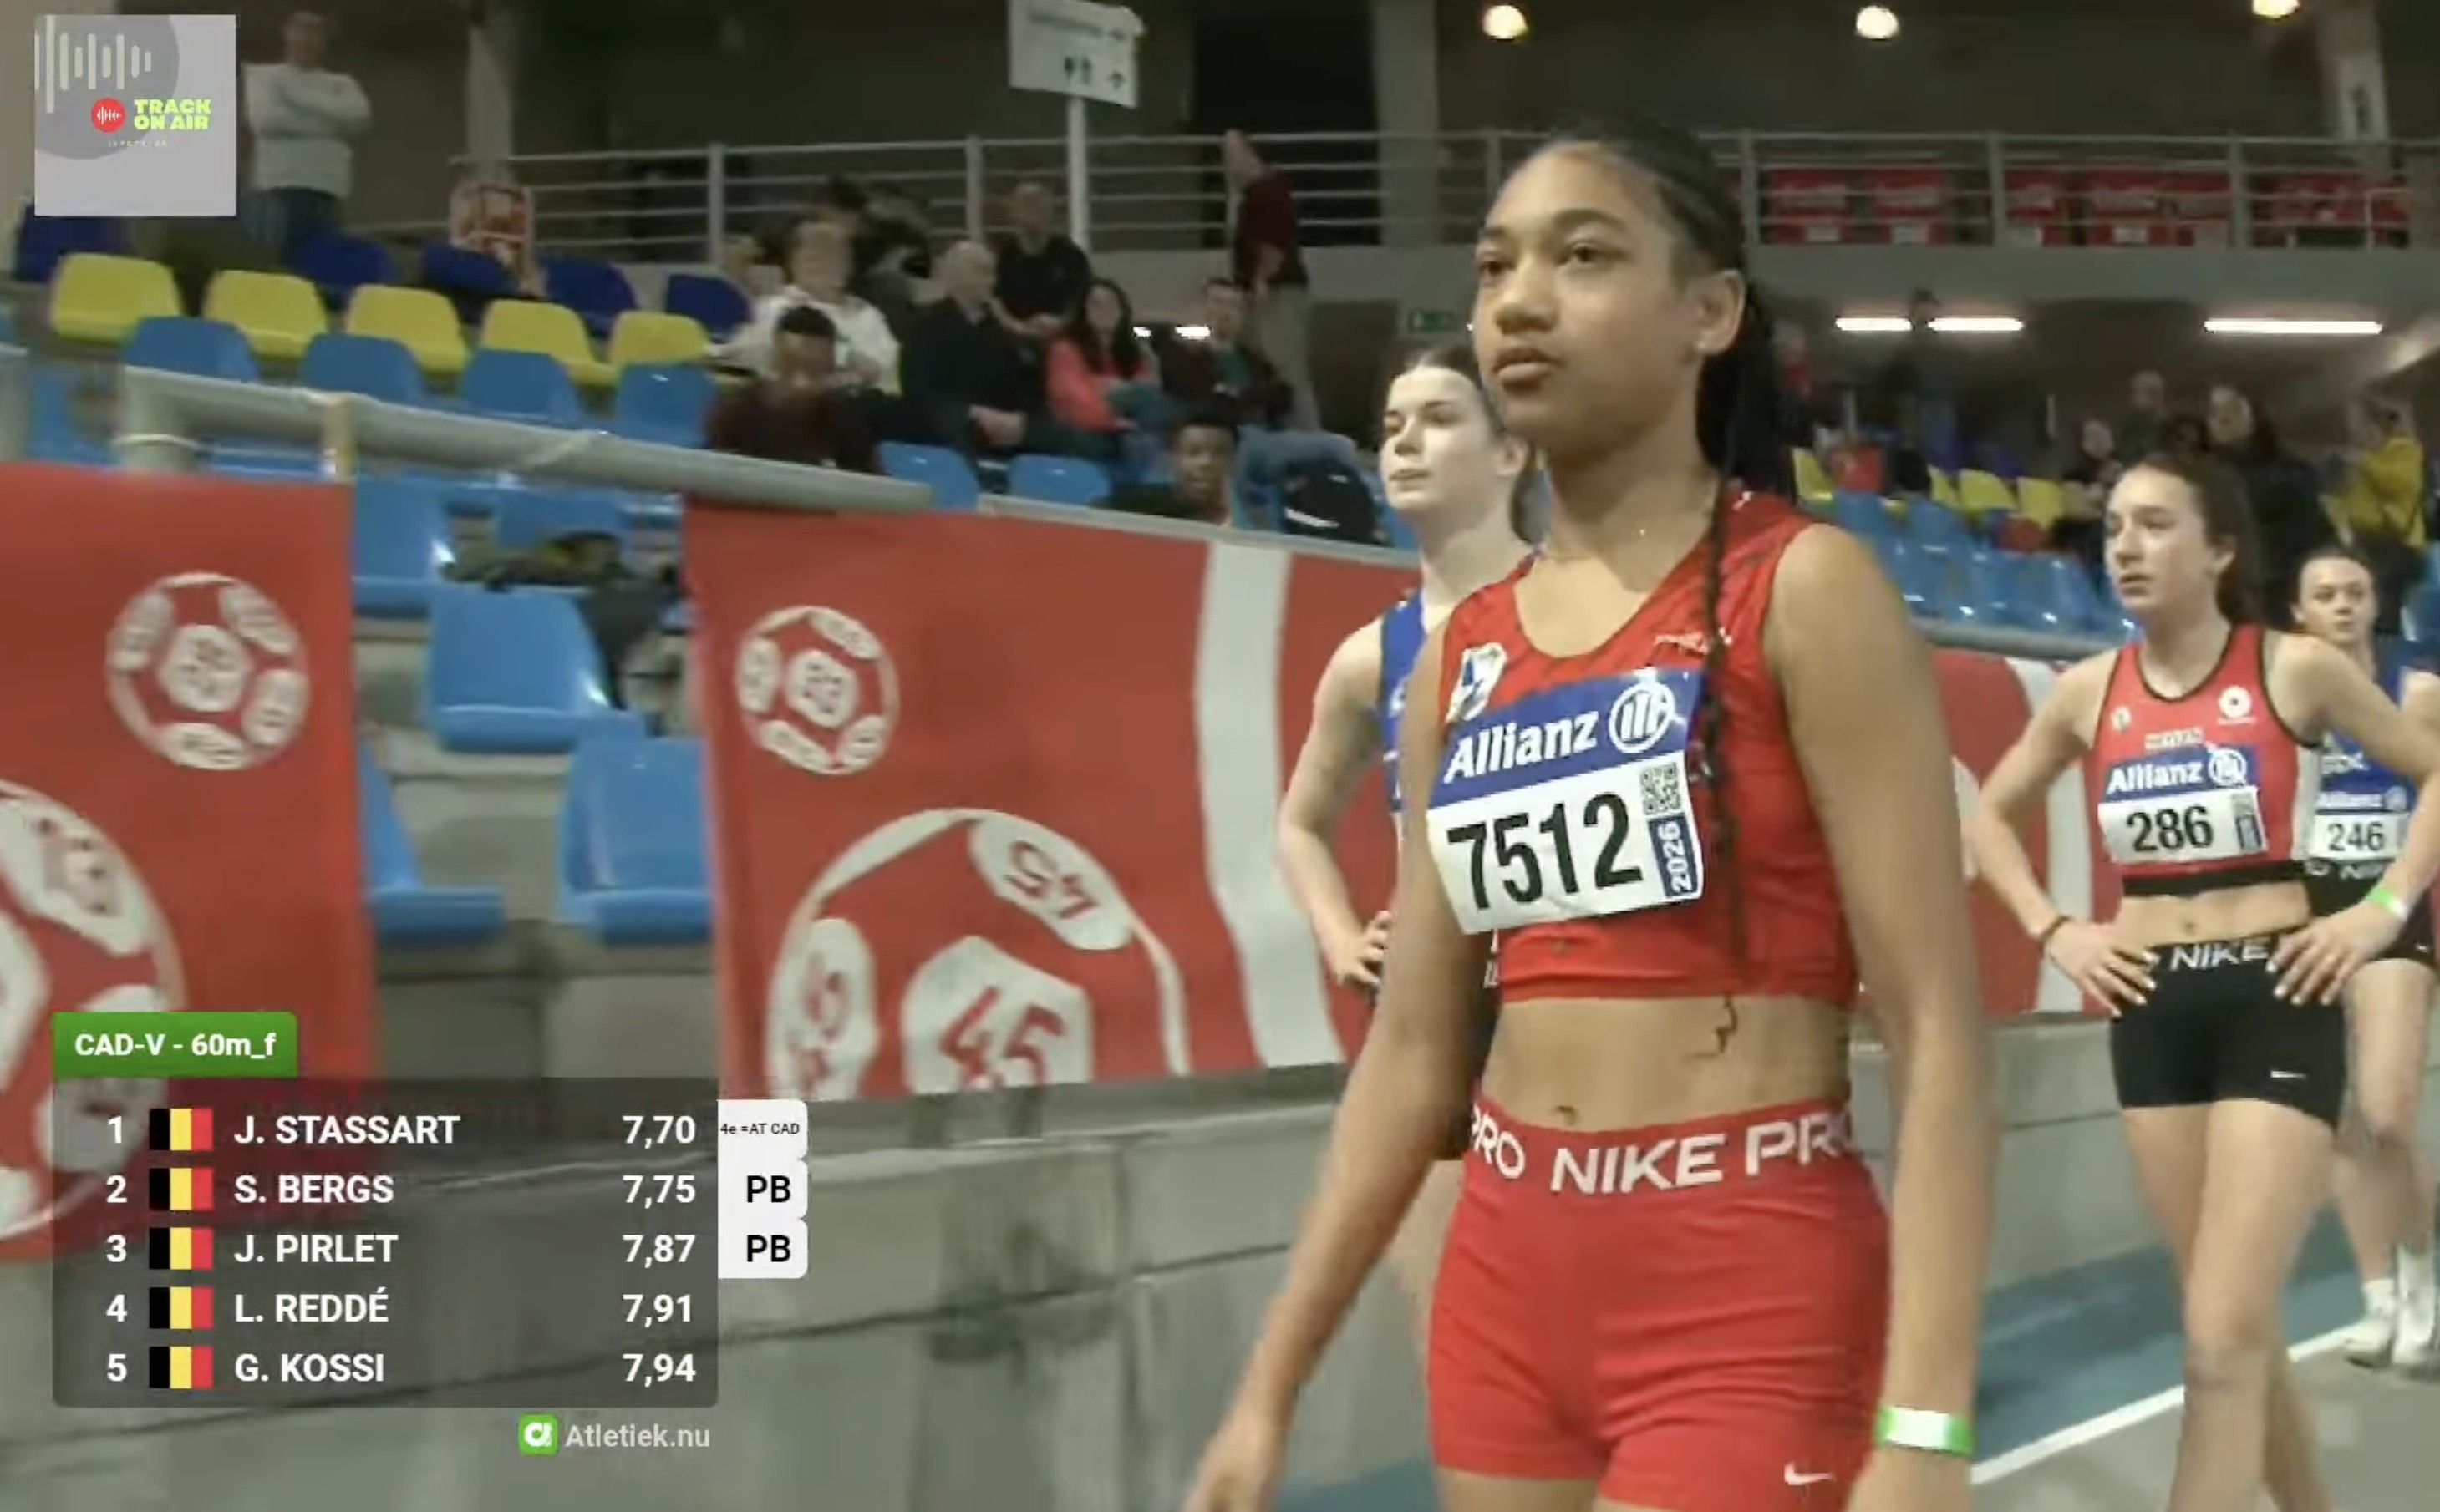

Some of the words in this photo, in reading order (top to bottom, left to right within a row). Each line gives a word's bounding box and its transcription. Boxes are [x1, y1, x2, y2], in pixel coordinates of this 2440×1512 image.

[1444, 711, 1599, 784] Allianz
[2105, 761, 2204, 794] Allianz
[1446, 791, 1644, 911] 7512
[1657, 820, 1693, 894] 2026
[2125, 805, 2214, 853] 286
[2327, 821, 2385, 852] 246
[2170, 936, 2270, 972] NIKE
[938, 986, 1065, 1086] 45
[1550, 1133, 1726, 1195] NIKE
